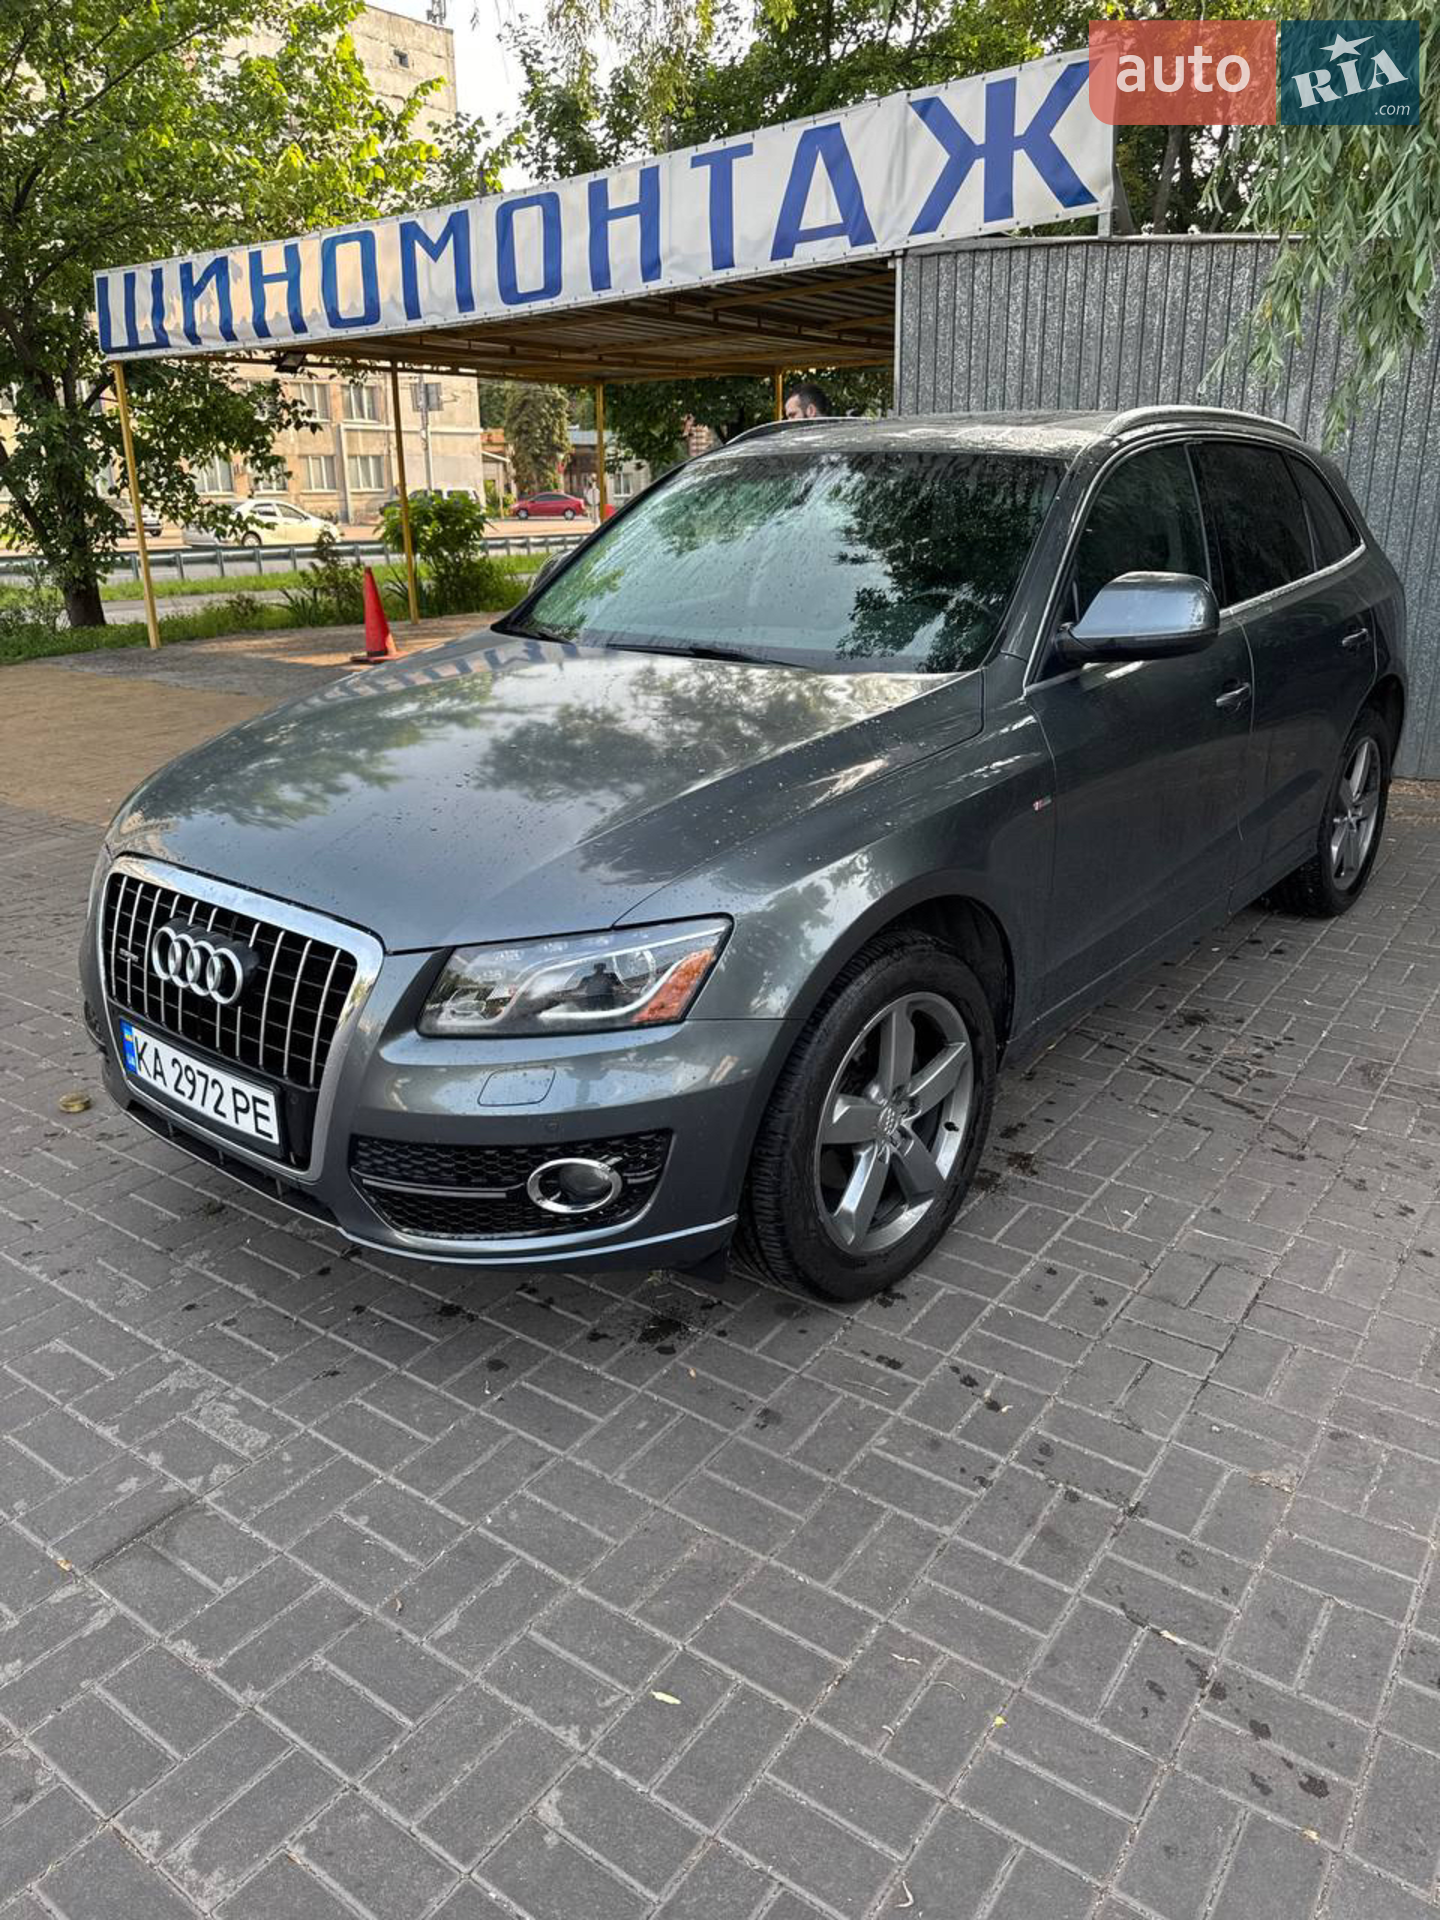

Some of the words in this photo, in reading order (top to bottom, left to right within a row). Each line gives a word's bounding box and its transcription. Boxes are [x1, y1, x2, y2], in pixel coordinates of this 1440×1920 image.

[96, 58, 1104, 354] ШИНОМОНТАЖ
[134, 1035, 168, 1089] KA
[171, 1057, 227, 1119] 2972
[231, 1086, 274, 1140] PE
